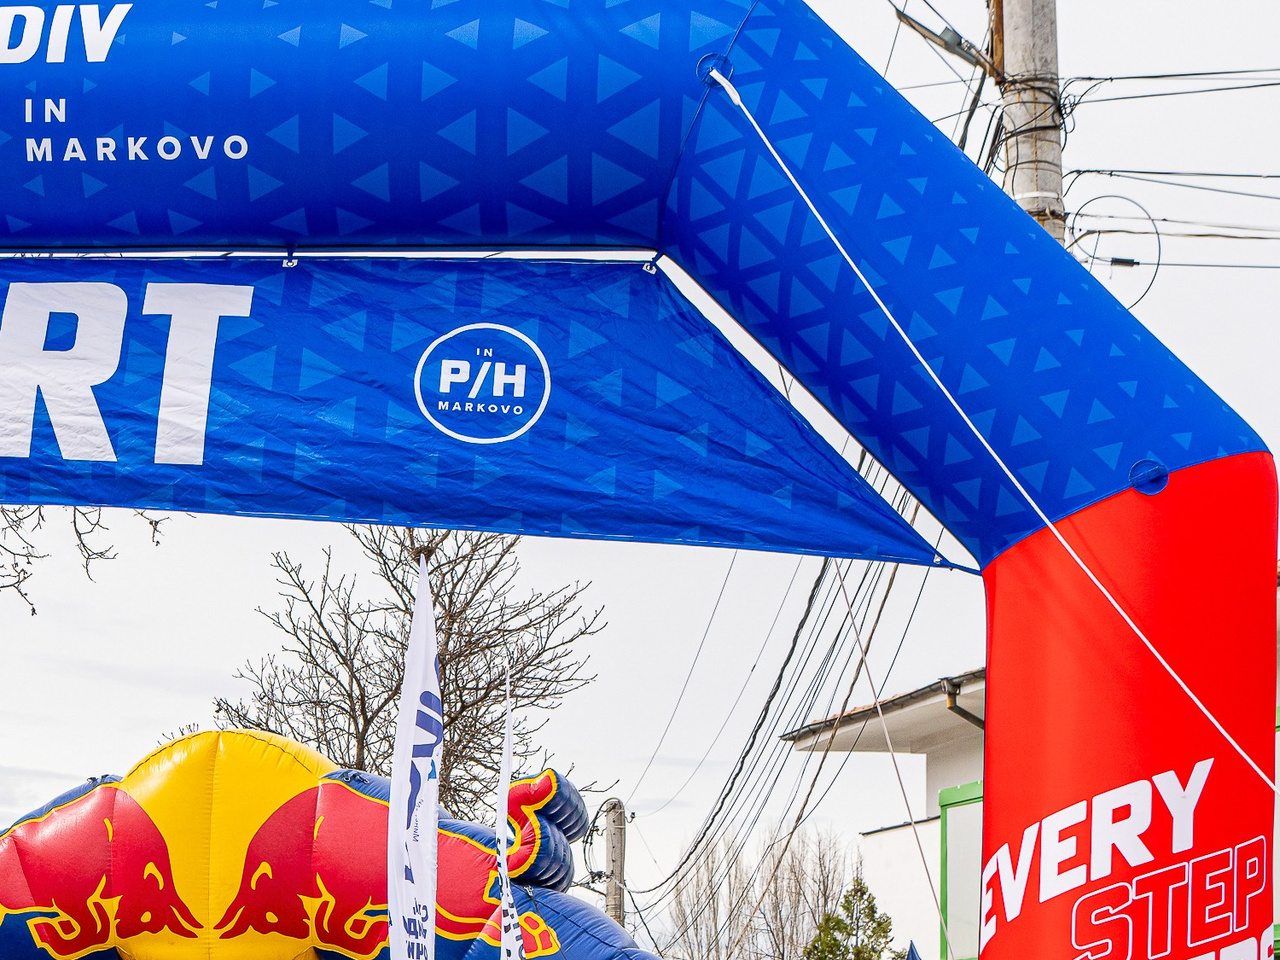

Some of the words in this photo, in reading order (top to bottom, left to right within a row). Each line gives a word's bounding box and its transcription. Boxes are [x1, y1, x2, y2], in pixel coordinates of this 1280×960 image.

[25, 98, 67, 123] IN
[26, 135, 249, 162] MARKOVO
[476, 348, 493, 357] IN
[439, 359, 526, 399] P/H
[438, 401, 523, 415] MARKOVO
[979, 758, 1214, 955] EVERY
